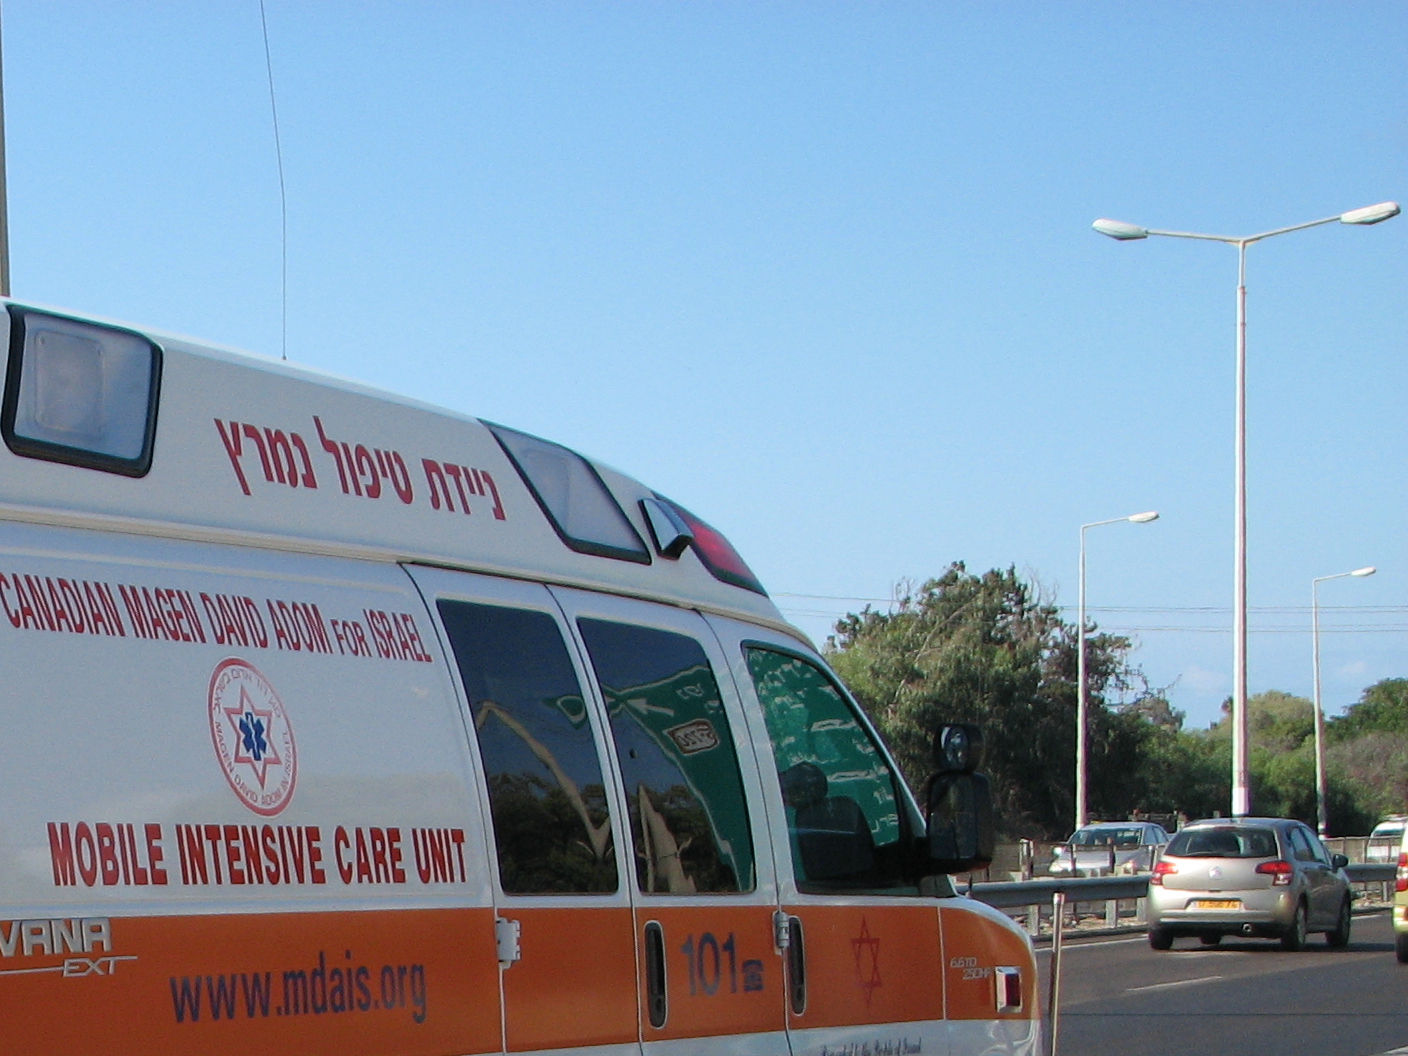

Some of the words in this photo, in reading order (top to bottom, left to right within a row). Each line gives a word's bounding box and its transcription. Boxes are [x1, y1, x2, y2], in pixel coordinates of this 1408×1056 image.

[213, 418, 318, 496] נמרץ
[313, 416, 414, 504] טיפול
[421, 458, 507, 521] ניידת
[117, 584, 207, 644] MAGEN
[199, 592, 268, 649] DAVID
[265, 599, 333, 654] ADOM
[330, 618, 368, 657] FOR
[363, 609, 433, 663] ISRAEL
[46, 821, 168, 888] MOBILE
[175, 823, 327, 886] INTENSIVE
[333, 825, 406, 885] CARE
[411, 827, 467, 884] UNIT
[63, 956, 125, 977] EXT
[169, 949, 427, 1024] www.mdais.org
[680, 932, 737, 996] 101
